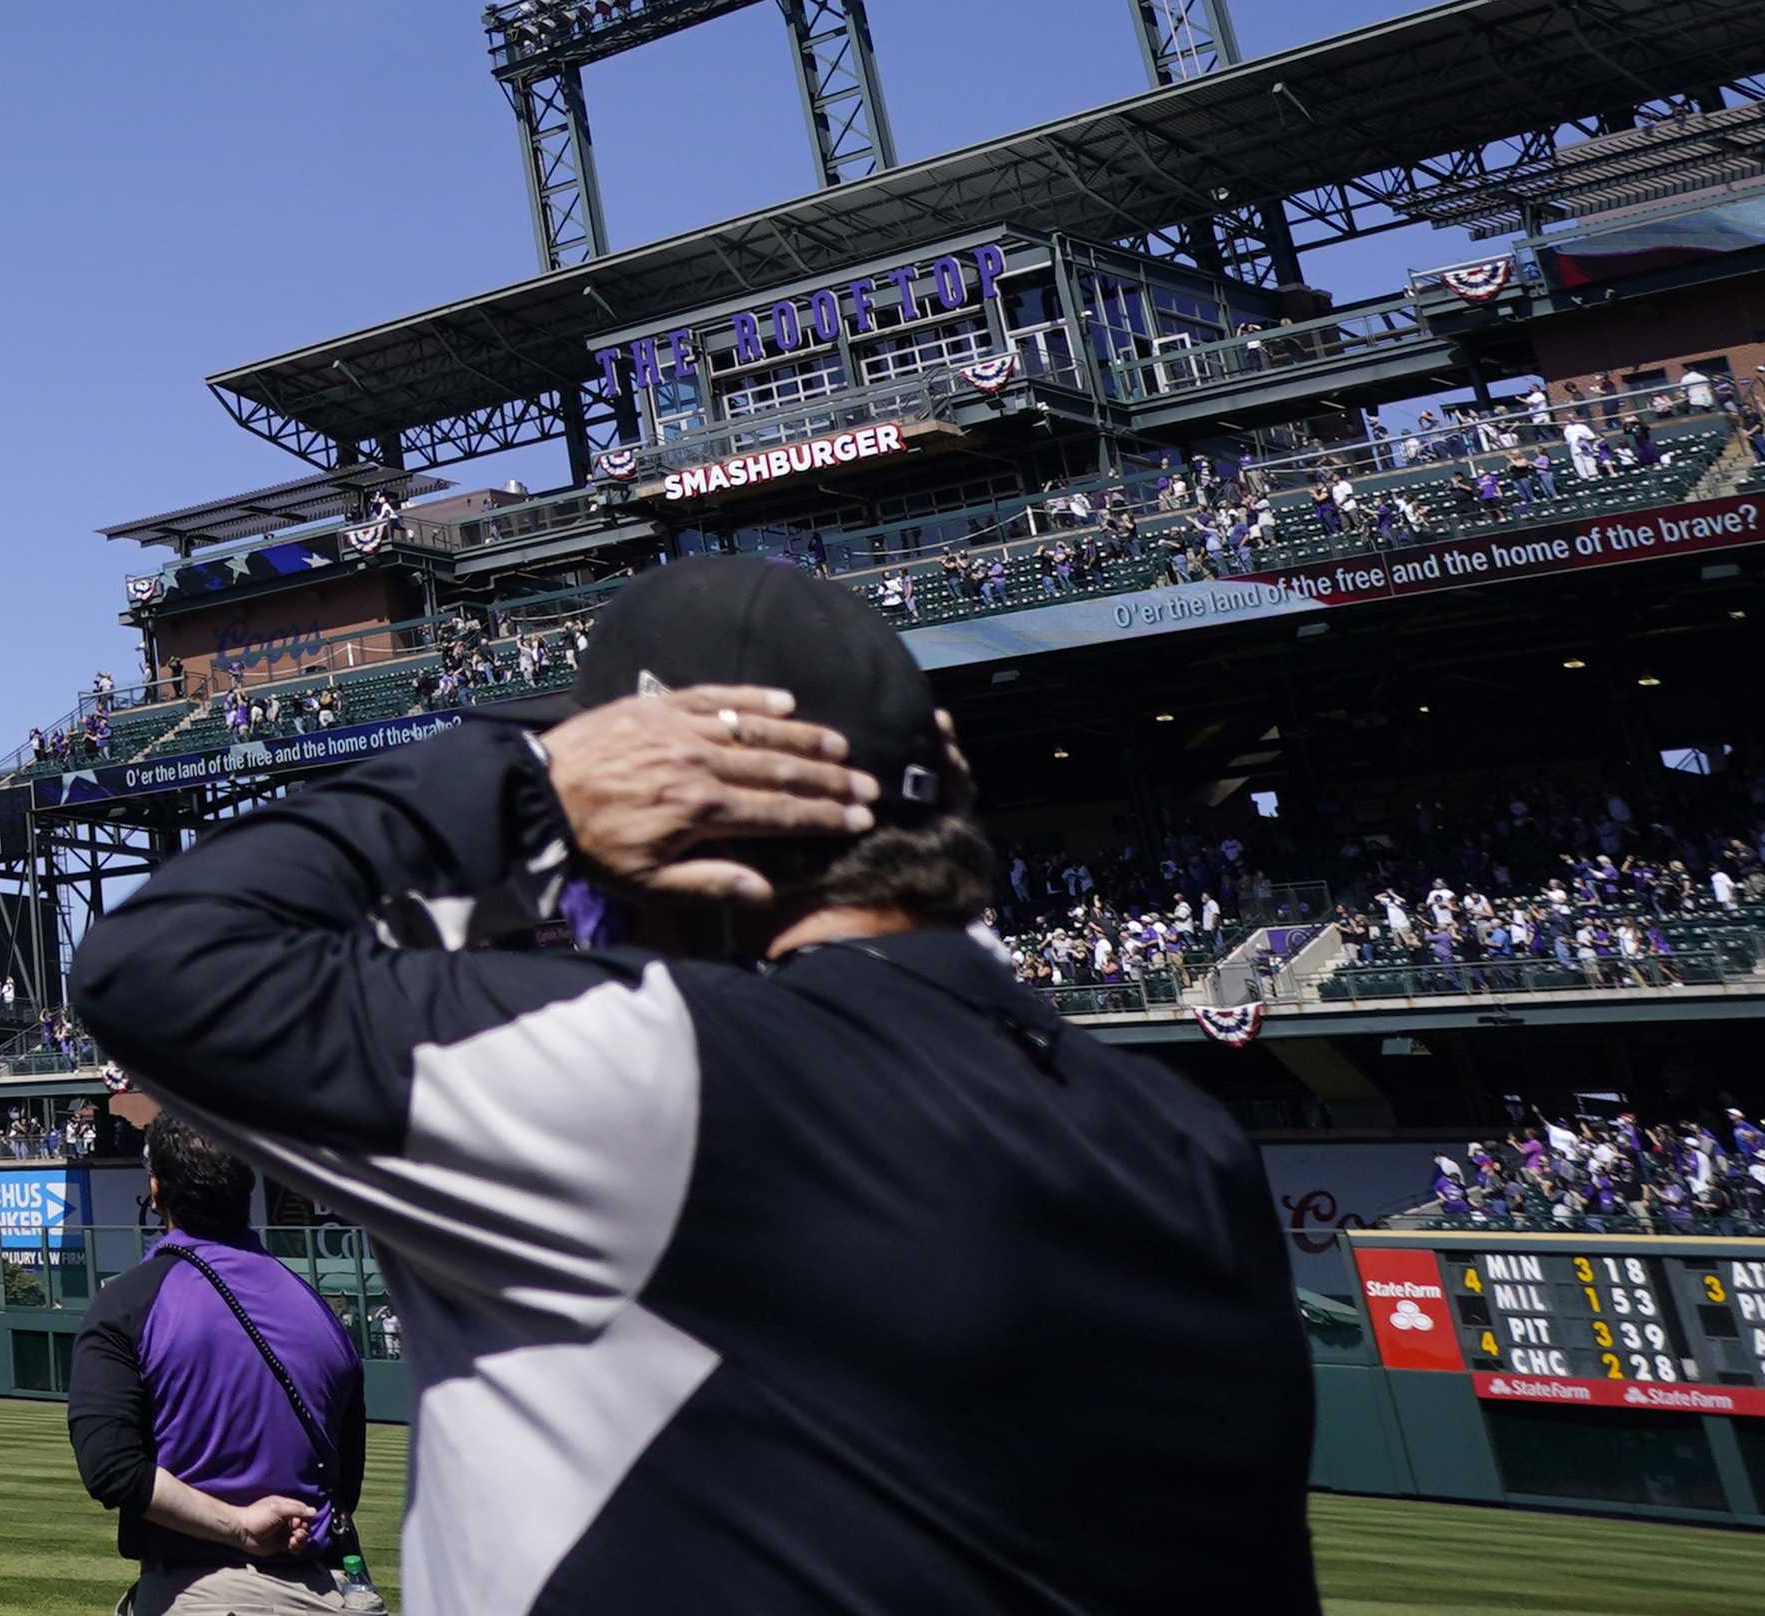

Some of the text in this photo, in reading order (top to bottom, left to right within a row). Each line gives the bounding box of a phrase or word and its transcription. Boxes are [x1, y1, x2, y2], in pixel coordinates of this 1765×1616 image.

[595, 245, 1008, 397] THE ROOFTOP
[664, 422, 908, 501] SMASHBURGER
[1114, 503, 1759, 628] O'er the land of the free and the home of the brave?
[126, 768, 155, 787] O'er
[155, 764, 176, 782] the
[177, 761, 205, 779] land
[207, 755, 222, 774] of
[223, 752, 245, 772] the
[247, 748, 272, 769] free
[275, 744, 300, 764] and
[303, 738, 326, 758] the
[328, 735, 367, 756] home
[370, 730, 385, 748] of
[386, 726, 409, 745] the
[38, 1252, 60, 1265] LW
[1485, 1254, 1546, 1282] MIN
[1574, 1257, 1595, 1283] 3
[1464, 1268, 1483, 1293] 4
[1703, 1275, 1727, 1304] 3
[1732, 1261, 1765, 1289] AT
[1494, 1284, 1547, 1312] MIL
[1586, 1287, 1601, 1313] 1
[1481, 1331, 1500, 1356] 4
[1507, 1317, 1551, 1345] PIT
[1592, 1321, 1613, 1349] 3
[1510, 1348, 1569, 1377] CHC
[1602, 1353, 1624, 1380] 2
